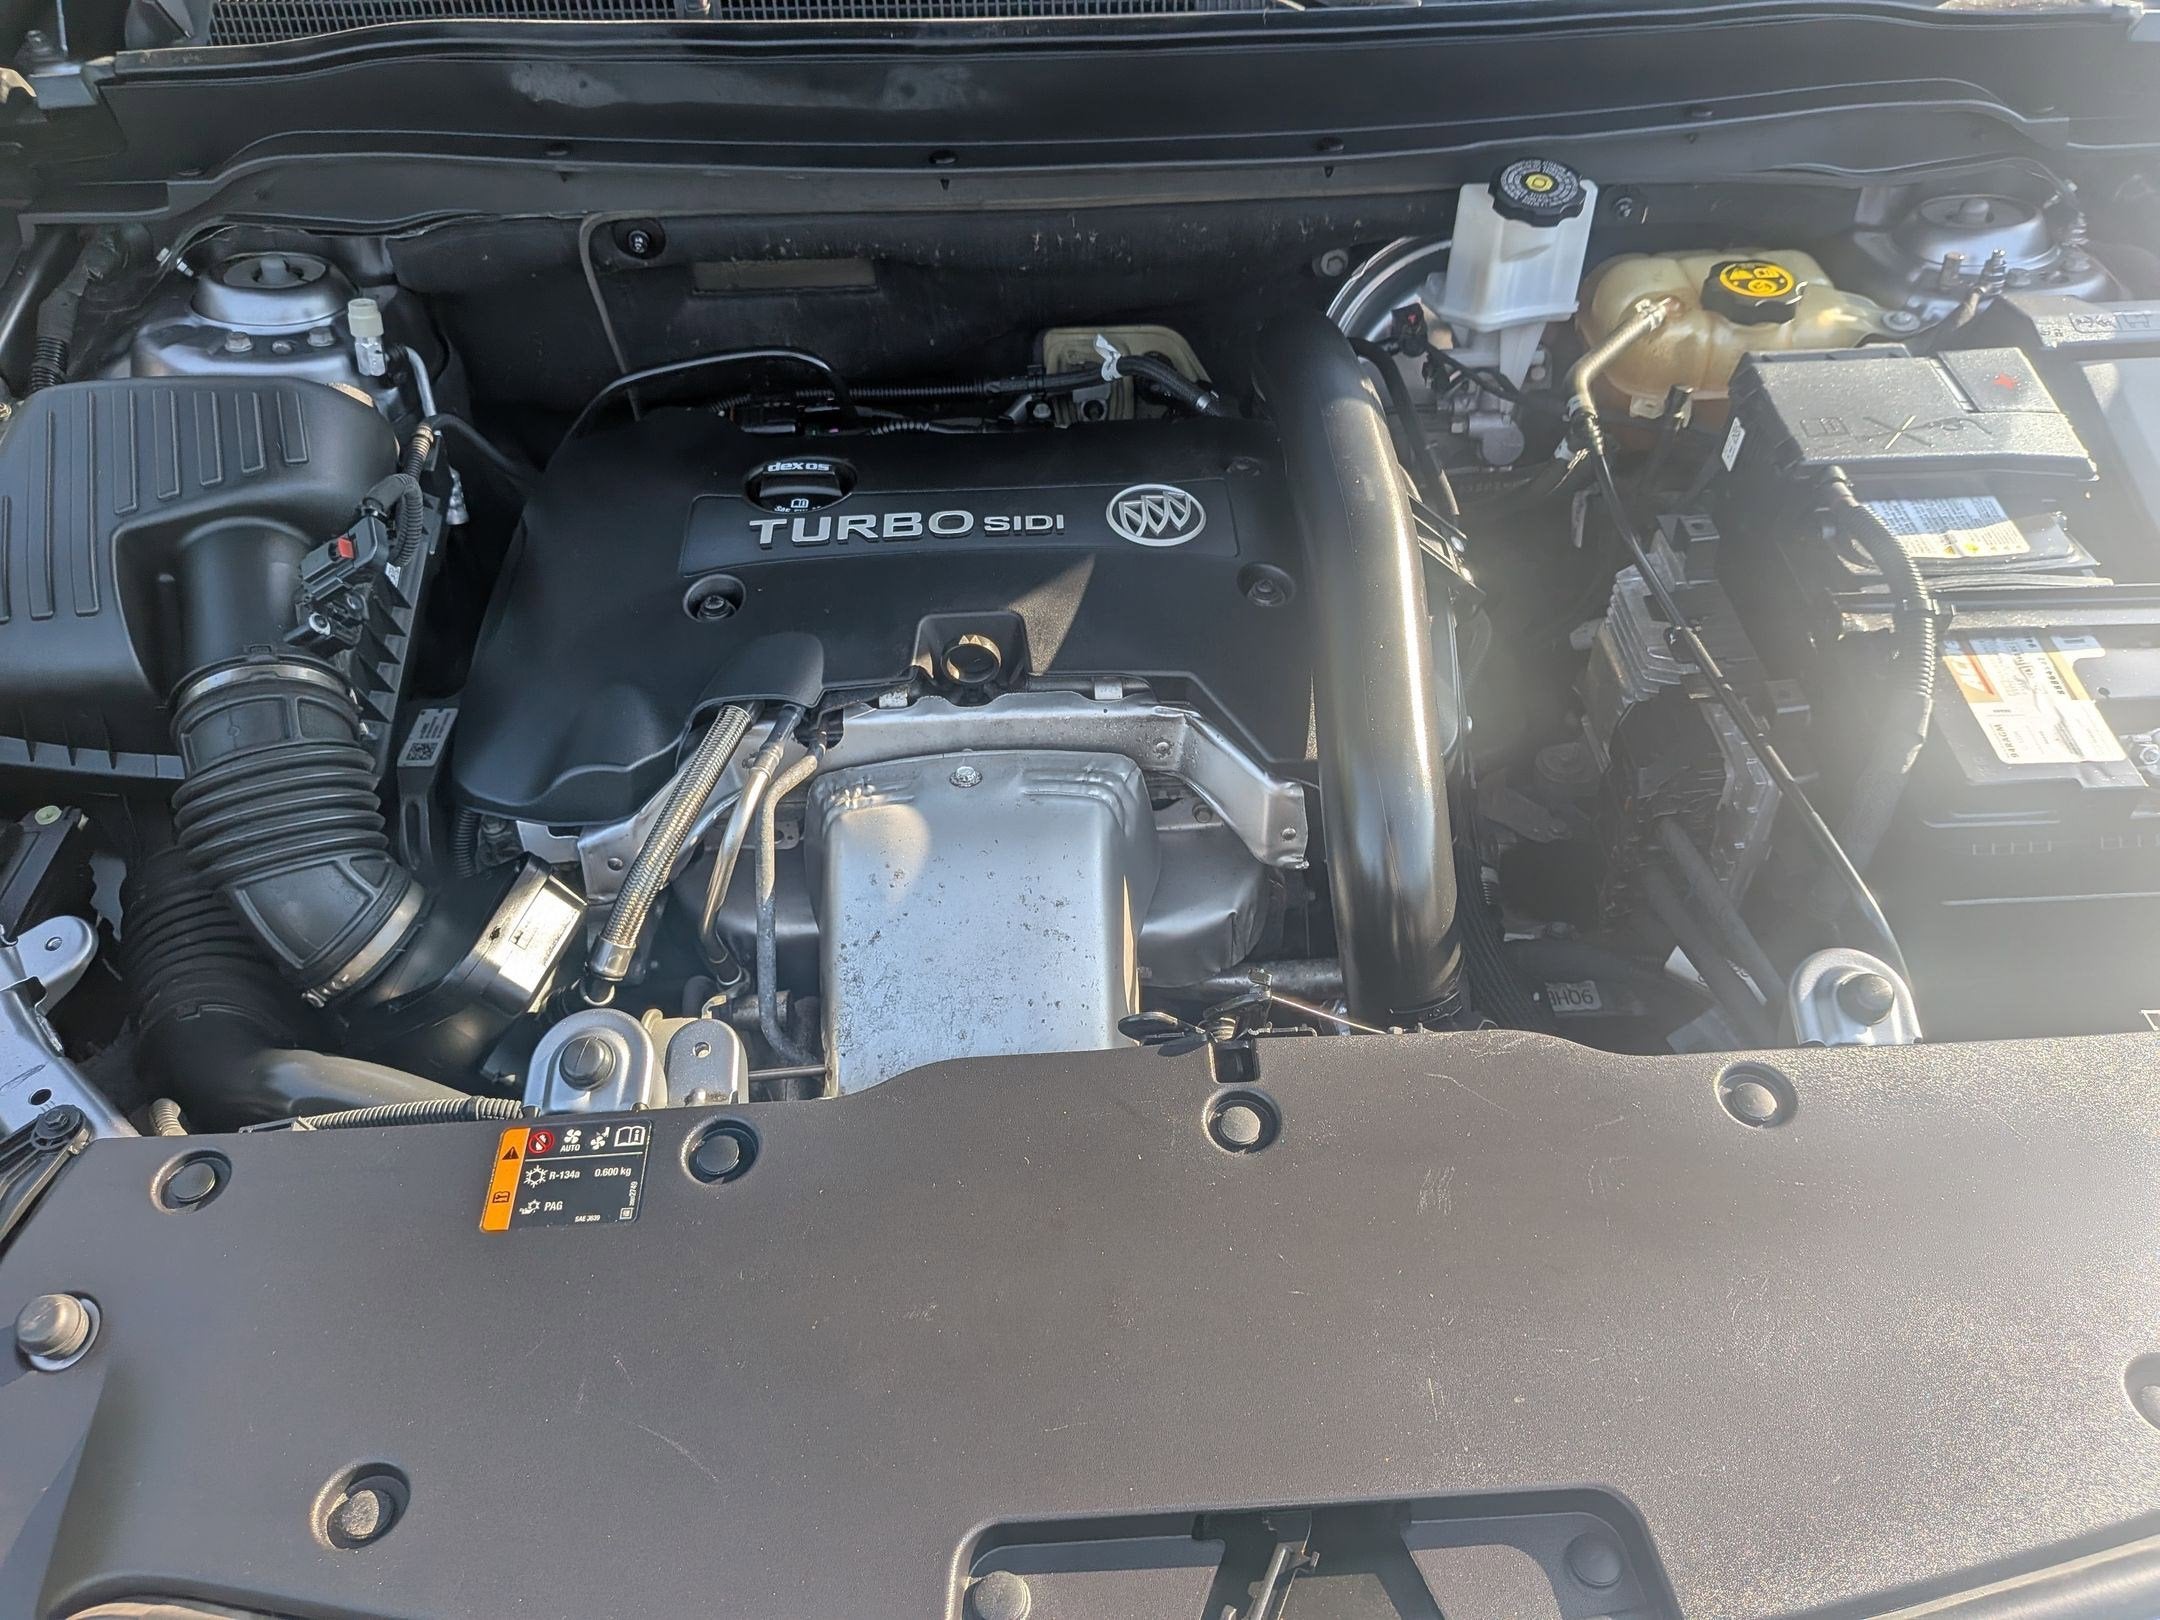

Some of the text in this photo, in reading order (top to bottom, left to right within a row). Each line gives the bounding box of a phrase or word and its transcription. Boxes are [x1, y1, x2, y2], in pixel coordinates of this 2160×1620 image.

[767, 462, 830, 472] dexos
[749, 510, 1064, 545] TURBO SIDI
[1994, 723, 2019, 758] 94RAGM
[560, 1143, 581, 1153] AUTO
[549, 1166, 632, 1180] R-134a 0.600 kg
[543, 1200, 563, 1212] PAG
[574, 1215, 586, 1223] SAE
